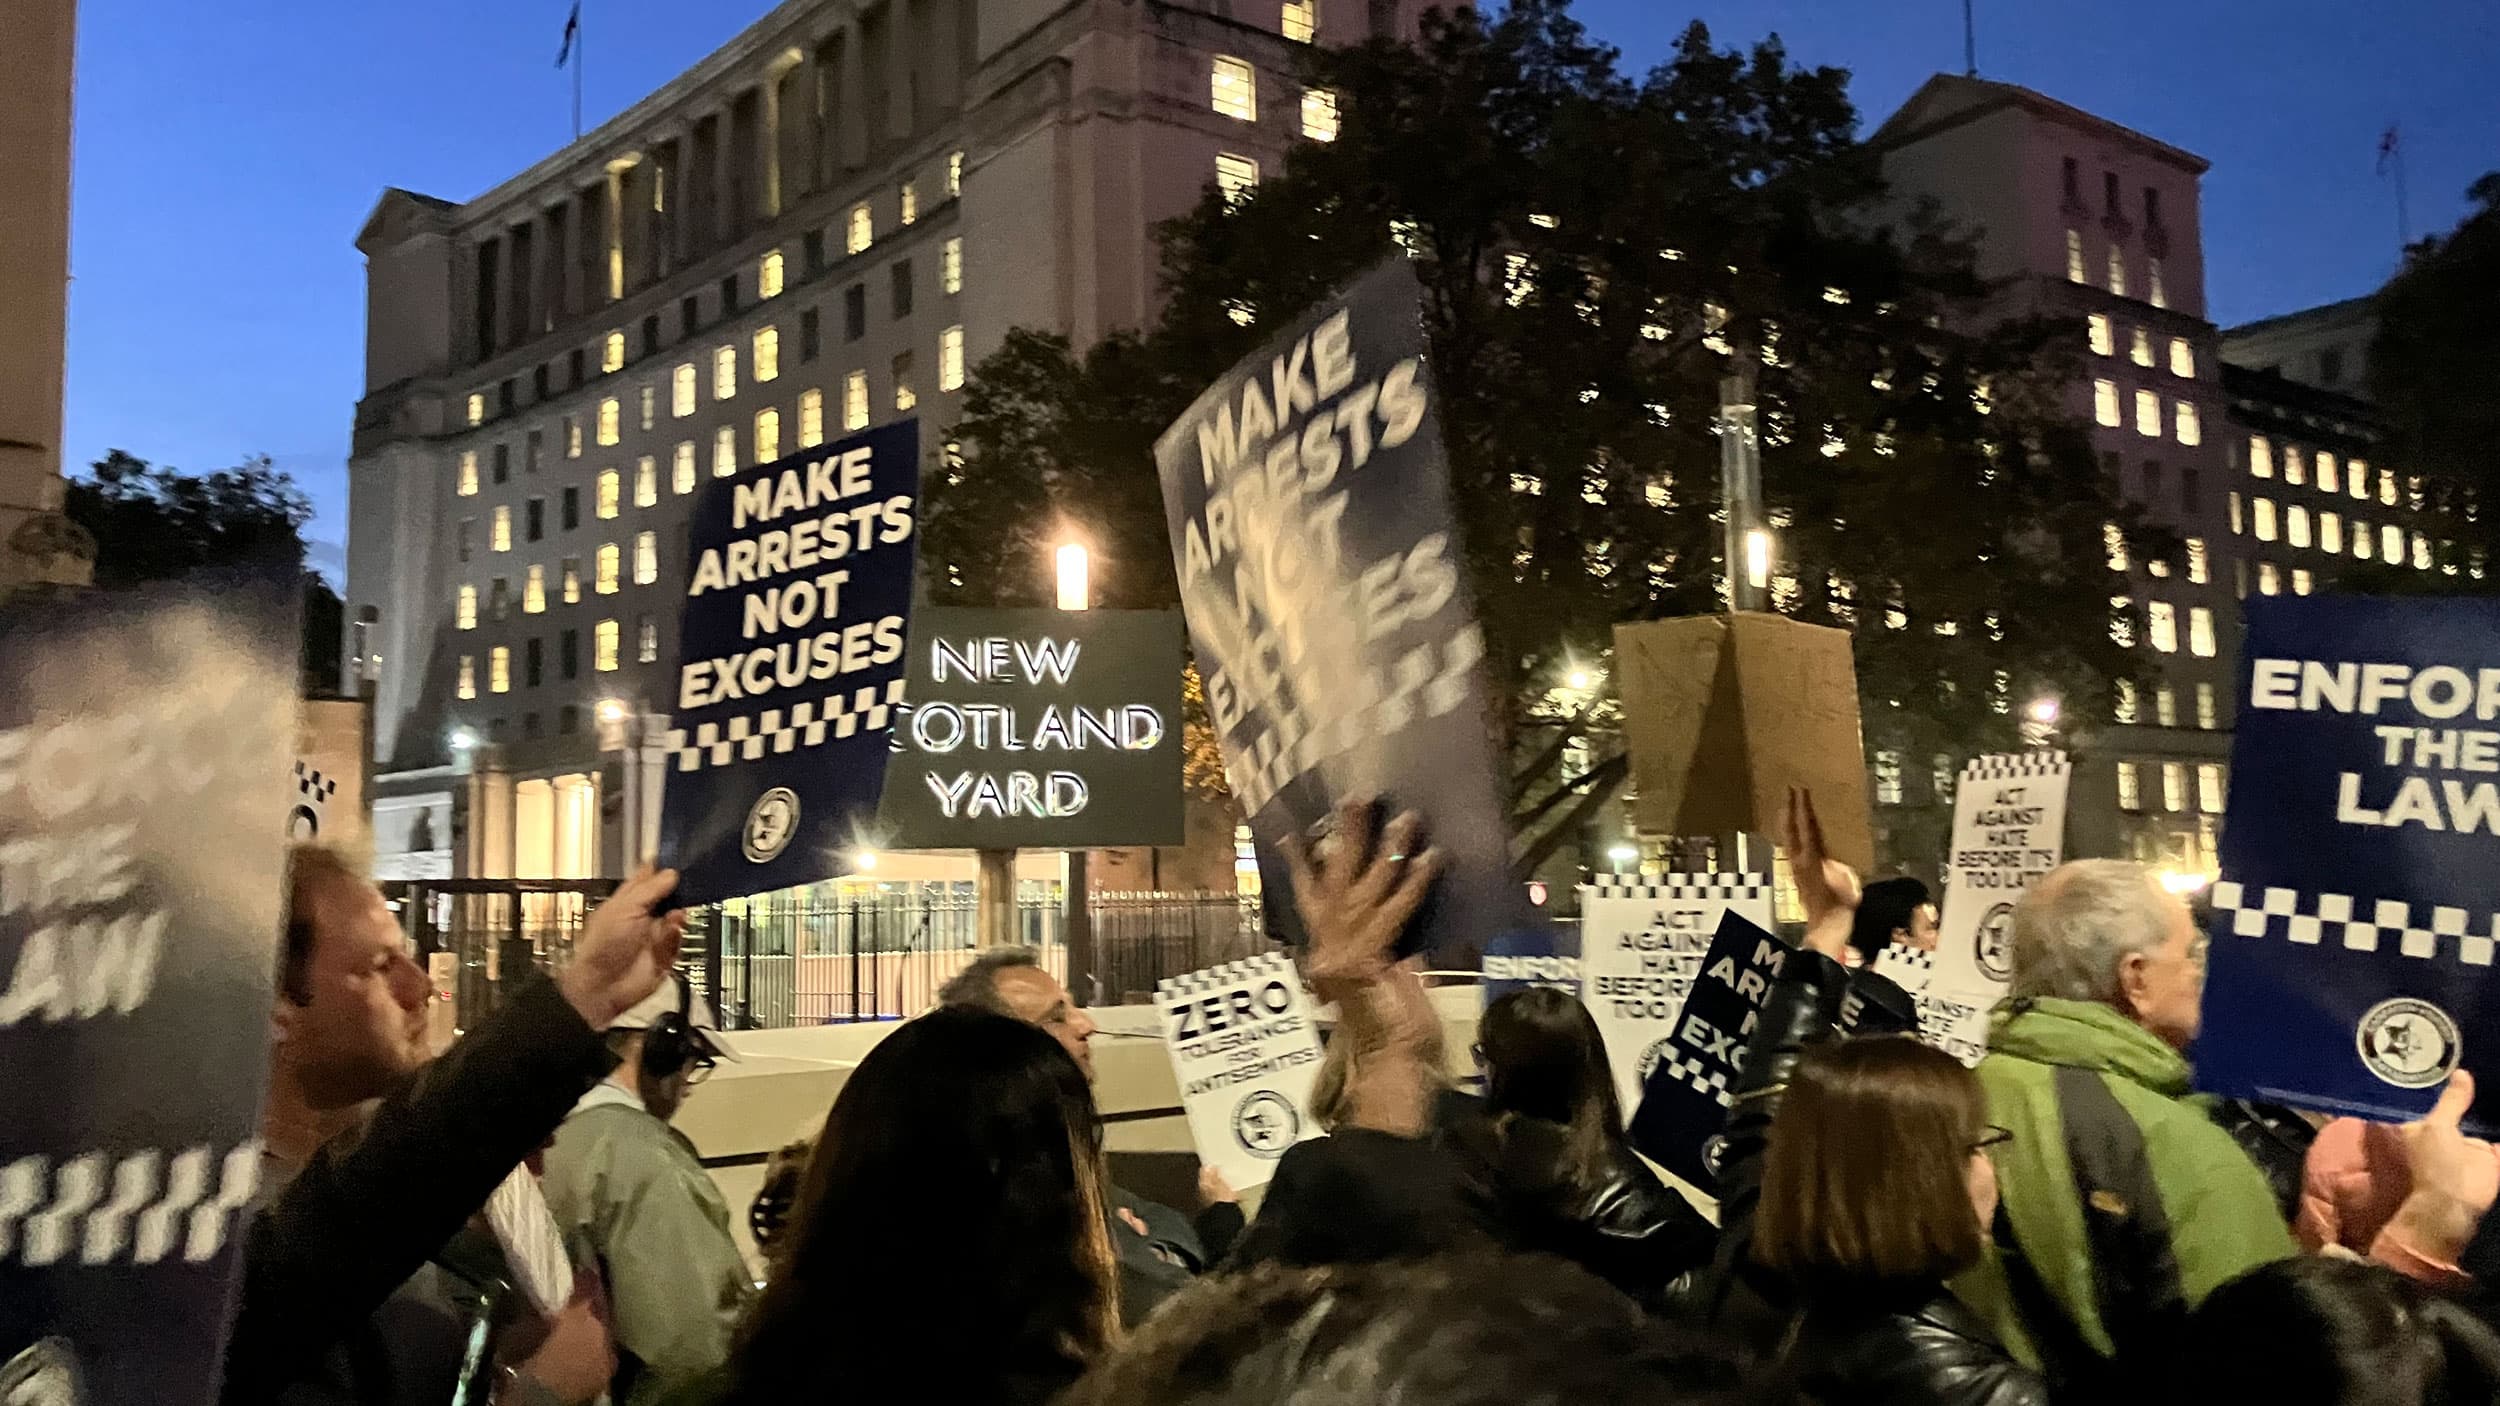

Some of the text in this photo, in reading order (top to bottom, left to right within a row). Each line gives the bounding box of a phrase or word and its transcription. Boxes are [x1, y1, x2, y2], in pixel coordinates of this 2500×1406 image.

[1197, 306, 1355, 488] MAKE
[732, 446, 873, 529] MAKE
[688, 495, 914, 597] ARRESTS
[742, 570, 849, 639] NOT
[679, 615, 905, 710] EXCUSES
[931, 636, 1081, 686] NEW
[2374, 725, 2500, 772] THE
[924, 770, 1090, 818] YARD
[1996, 788, 2027, 805] ACT
[2336, 772, 2500, 836] LAW
[1975, 808, 2044, 827] AGAINST
[1986, 829, 2029, 847] HATE
[1957, 850, 2021, 868] BEFORE
[1966, 870, 1999, 889] TOO
[1653, 910, 1704, 929] ACT
[1595, 976, 1697, 996] BEFOR
[1642, 955, 1706, 975] HAT
[1168, 981, 1289, 1041] ZERO
[1612, 1000, 1671, 1020] TOO
[1178, 1016, 1304, 1061] TOLERANCE
[1227, 1047, 1264, 1062] FOR
